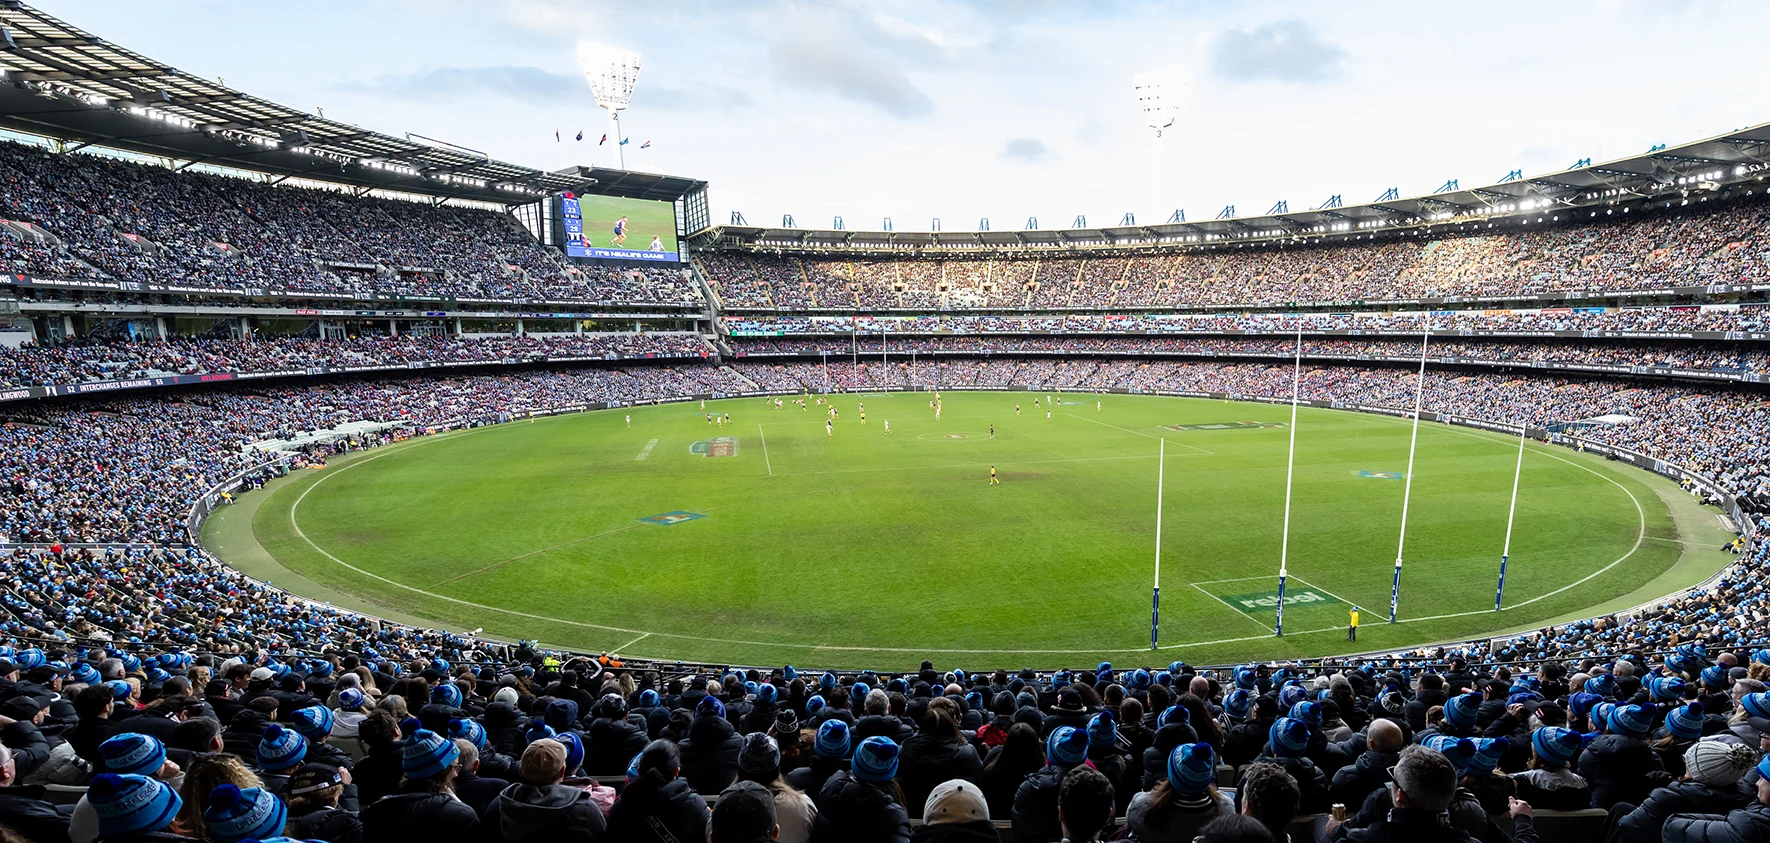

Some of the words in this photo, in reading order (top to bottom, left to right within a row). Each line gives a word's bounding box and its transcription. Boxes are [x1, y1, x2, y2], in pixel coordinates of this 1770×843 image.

[80, 382, 120, 392] INTERCHANGES
[121, 380, 151, 388] REMAINING
[1240, 591, 1326, 608] rebel
